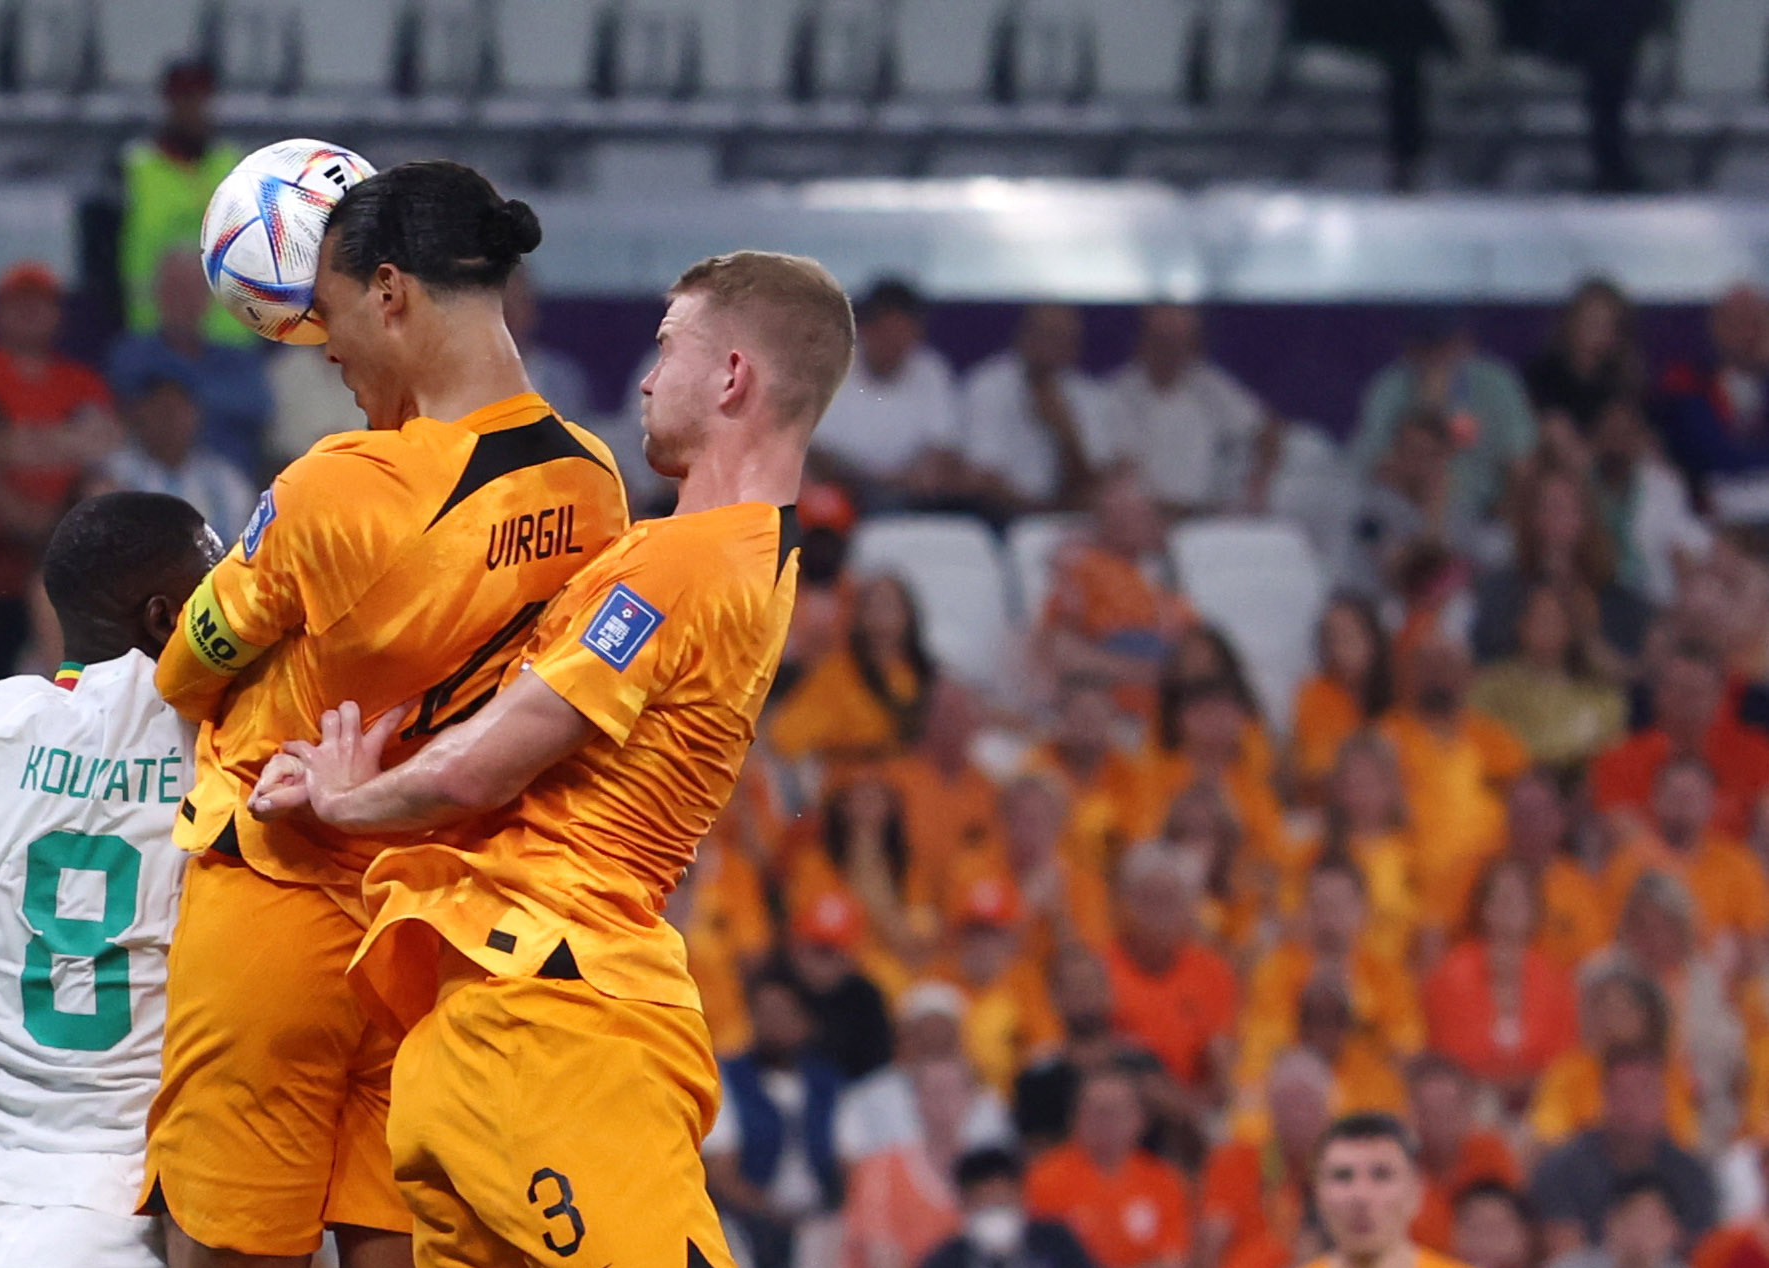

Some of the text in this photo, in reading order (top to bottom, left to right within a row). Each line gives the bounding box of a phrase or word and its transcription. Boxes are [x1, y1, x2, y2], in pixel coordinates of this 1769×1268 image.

[486, 504, 584, 571] VIRGIL
[196, 607, 238, 661] NO
[21, 829, 142, 1052] 8
[527, 1167, 586, 1258] 3
